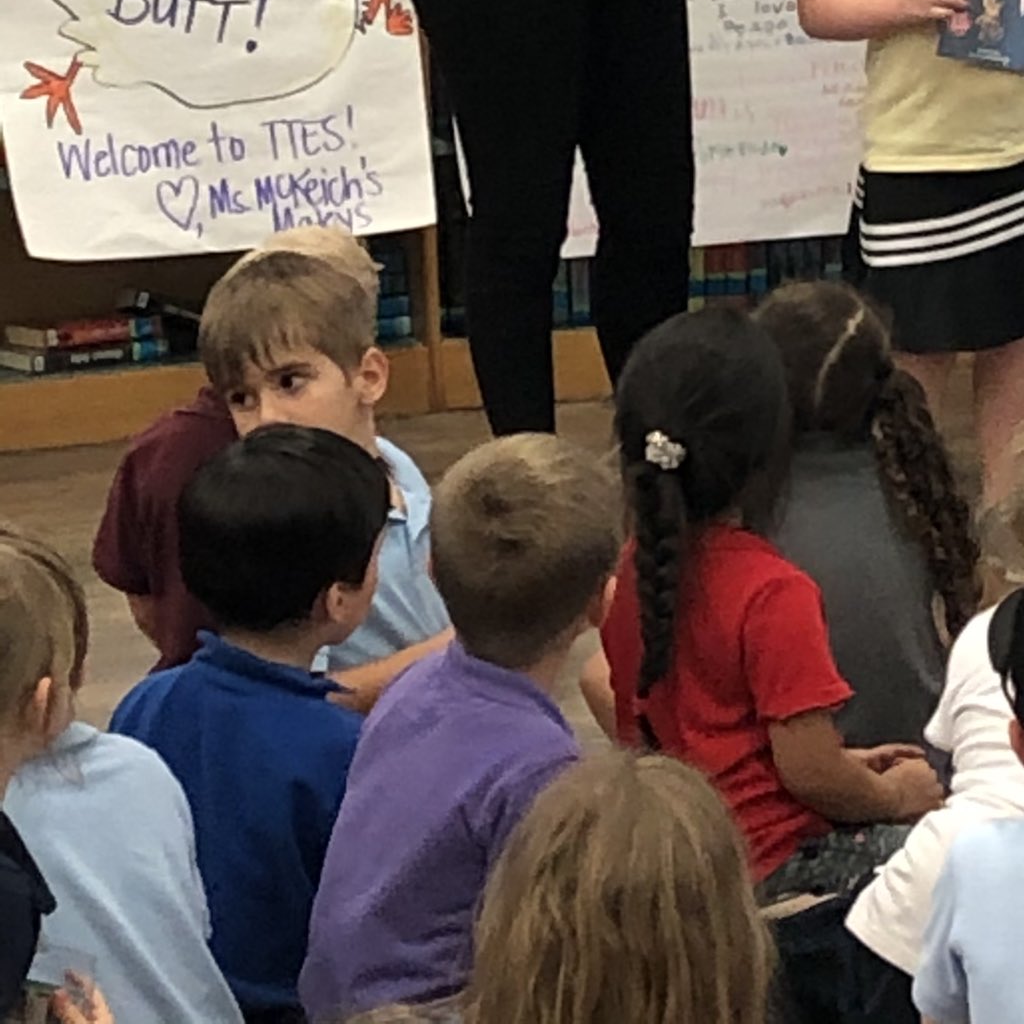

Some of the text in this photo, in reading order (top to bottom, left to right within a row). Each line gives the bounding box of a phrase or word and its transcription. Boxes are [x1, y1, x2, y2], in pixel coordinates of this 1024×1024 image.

[57, 104, 359, 182] Welcome to TTES!
